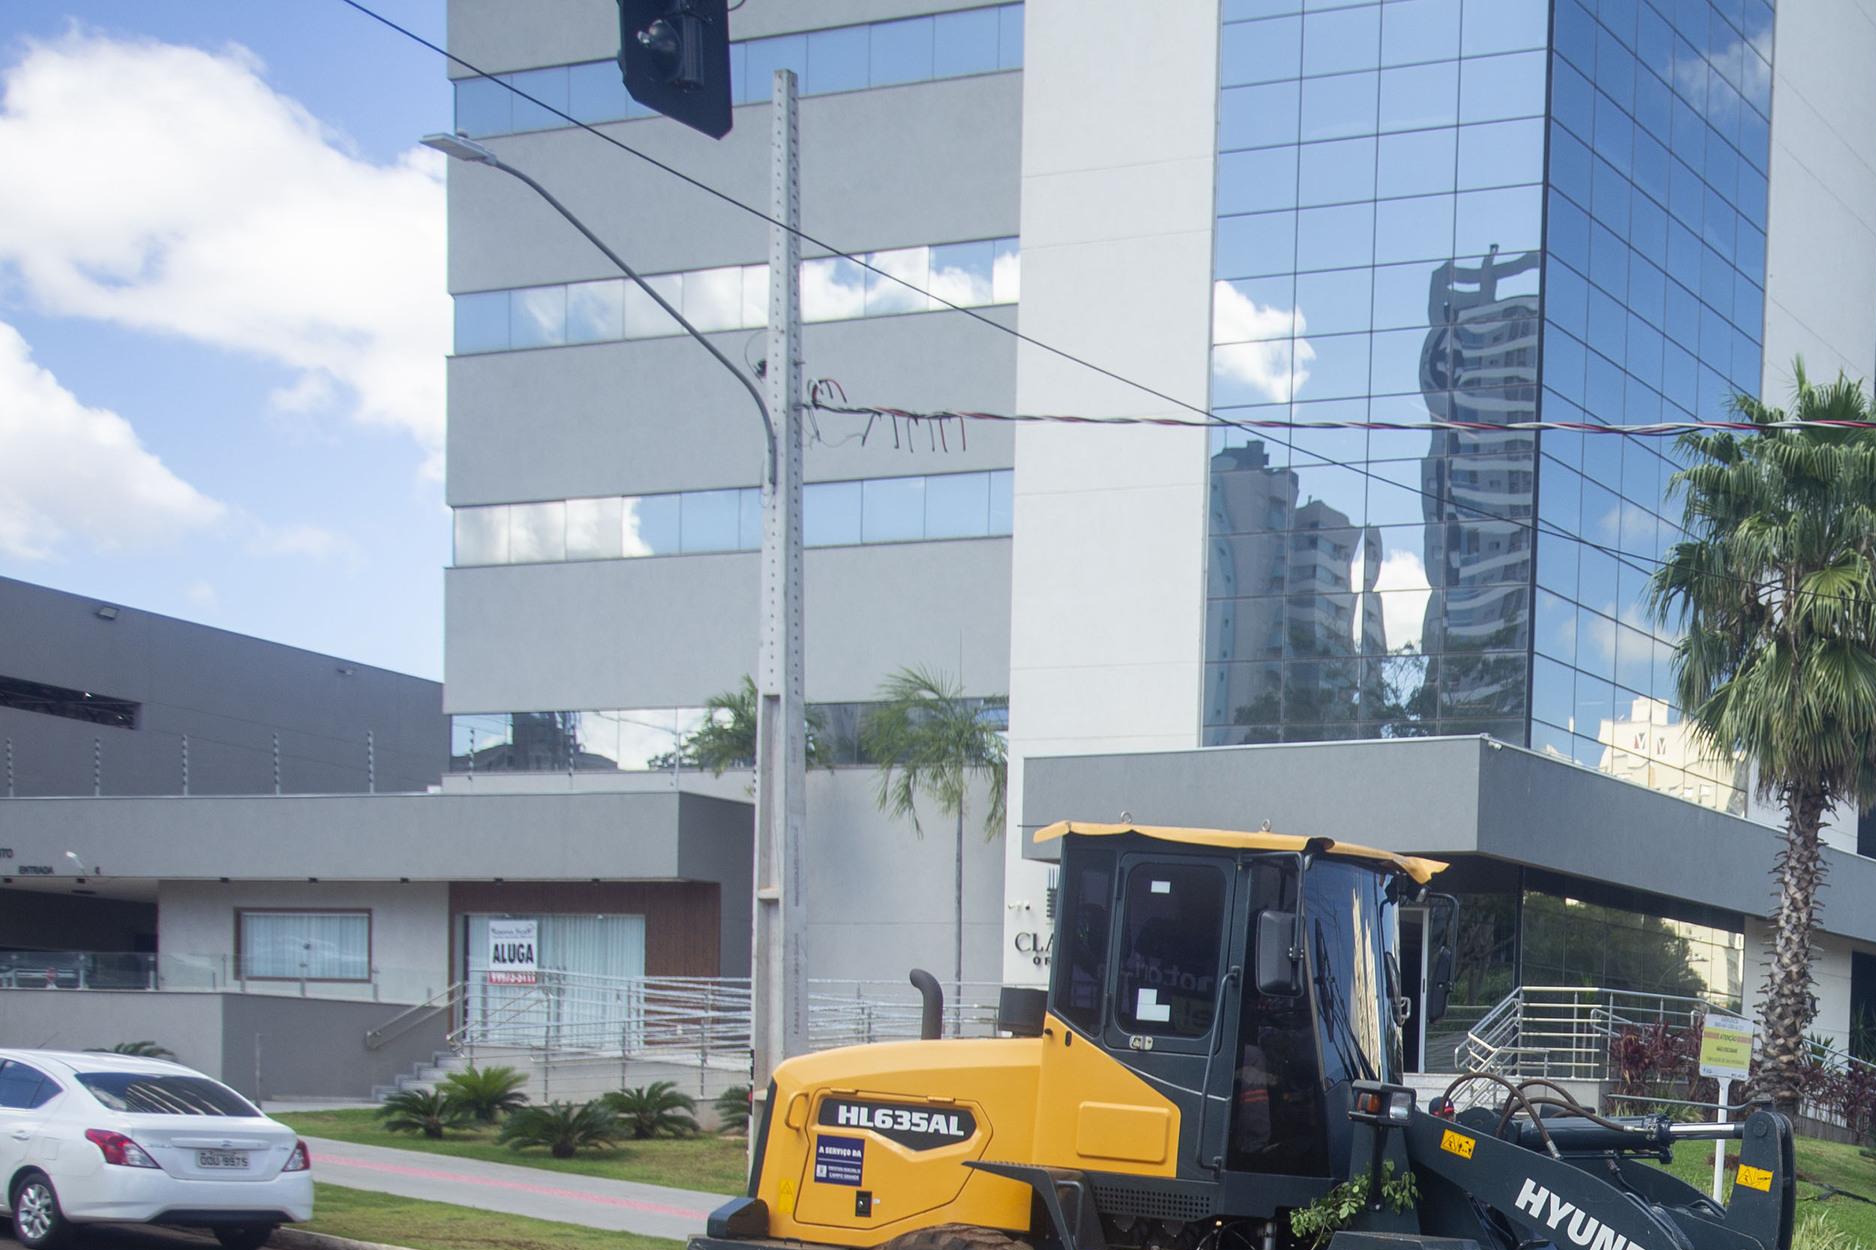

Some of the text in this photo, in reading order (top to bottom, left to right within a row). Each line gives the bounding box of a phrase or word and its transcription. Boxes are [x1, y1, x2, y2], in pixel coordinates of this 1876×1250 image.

[493, 943, 535, 964] ALUGA
[837, 1104, 965, 1137] HL635AL
[818, 1145, 862, 1158] A SERVIÇO DA
